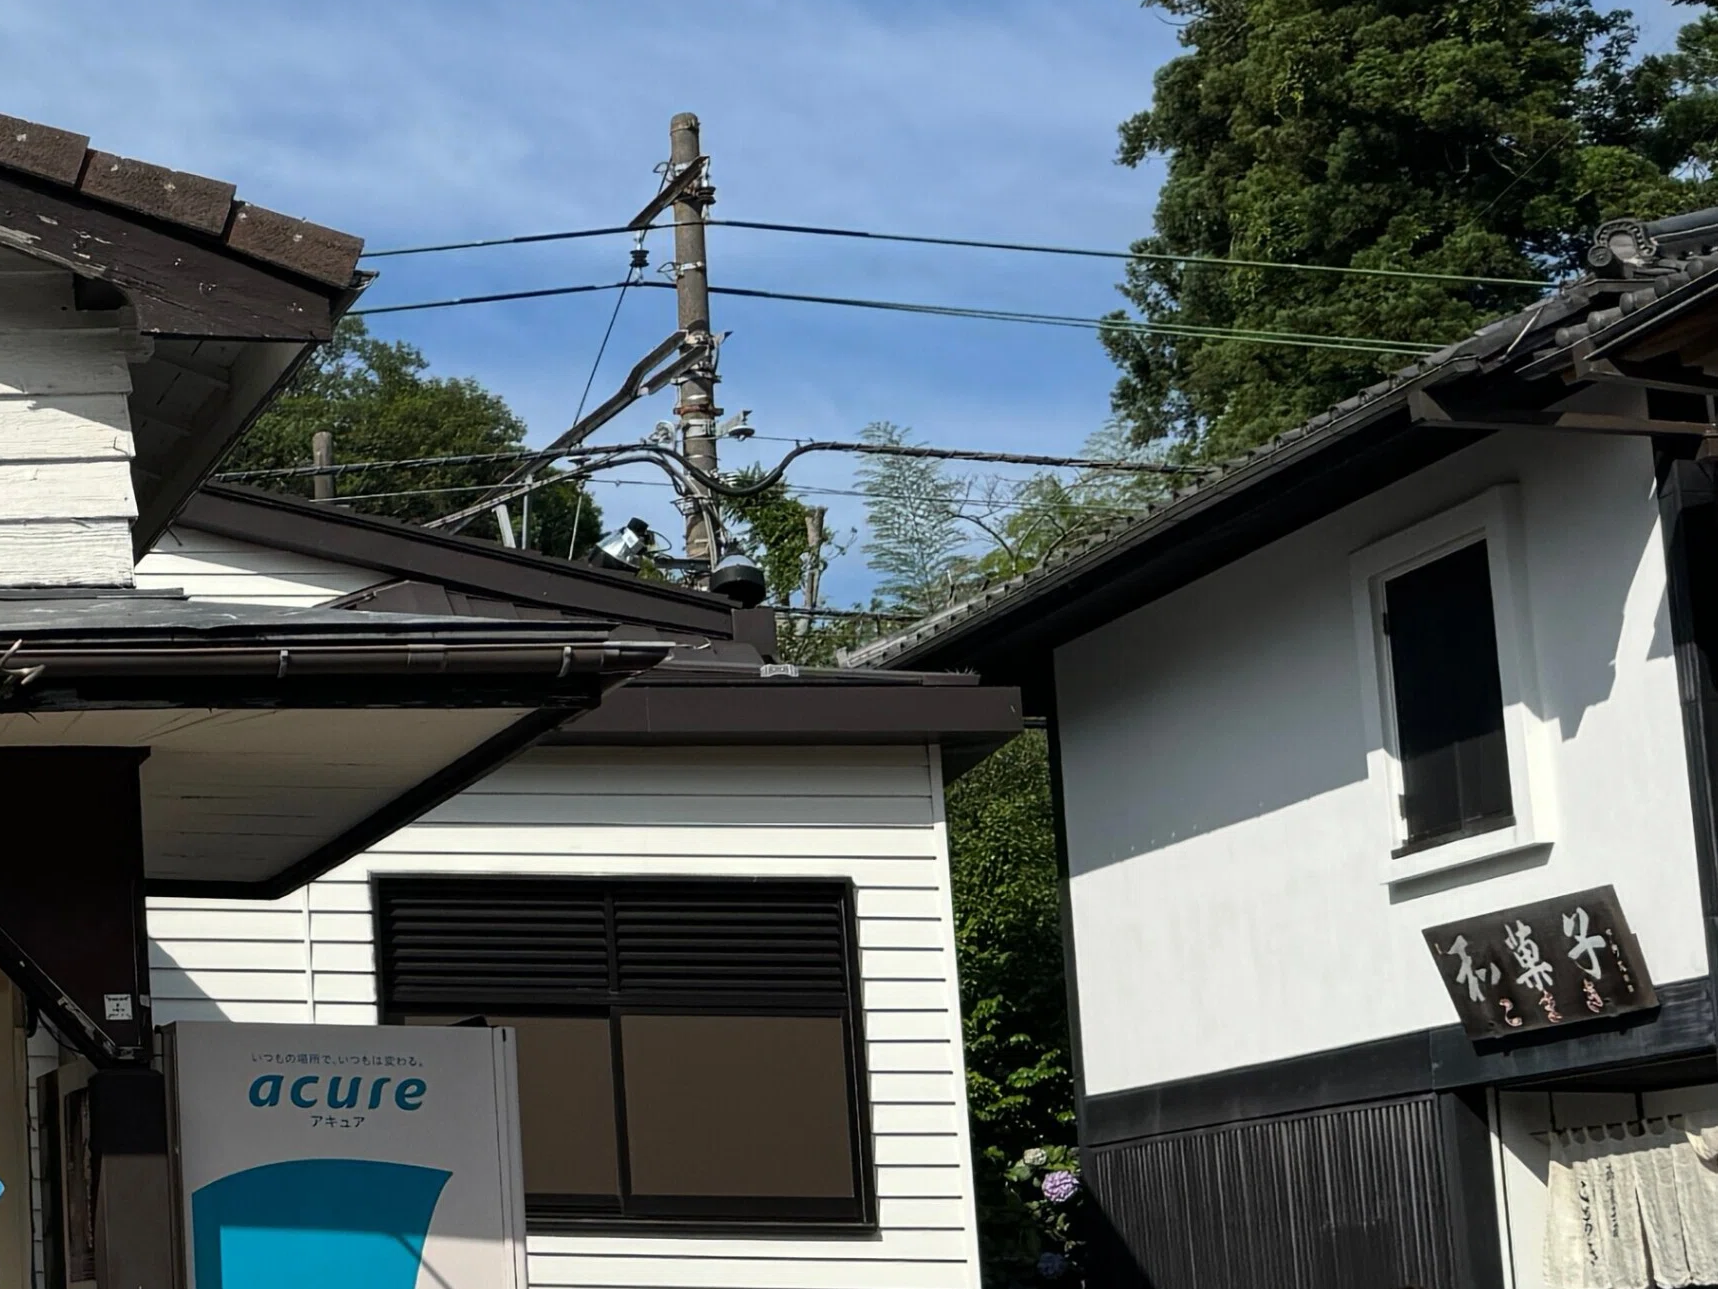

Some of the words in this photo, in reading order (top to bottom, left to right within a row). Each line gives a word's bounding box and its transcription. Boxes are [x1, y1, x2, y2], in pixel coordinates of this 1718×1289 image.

[1446, 906, 1607, 1003] 和菓子
[248, 1073, 428, 1112] acure
[310, 1114, 366, 1129] アキュア
